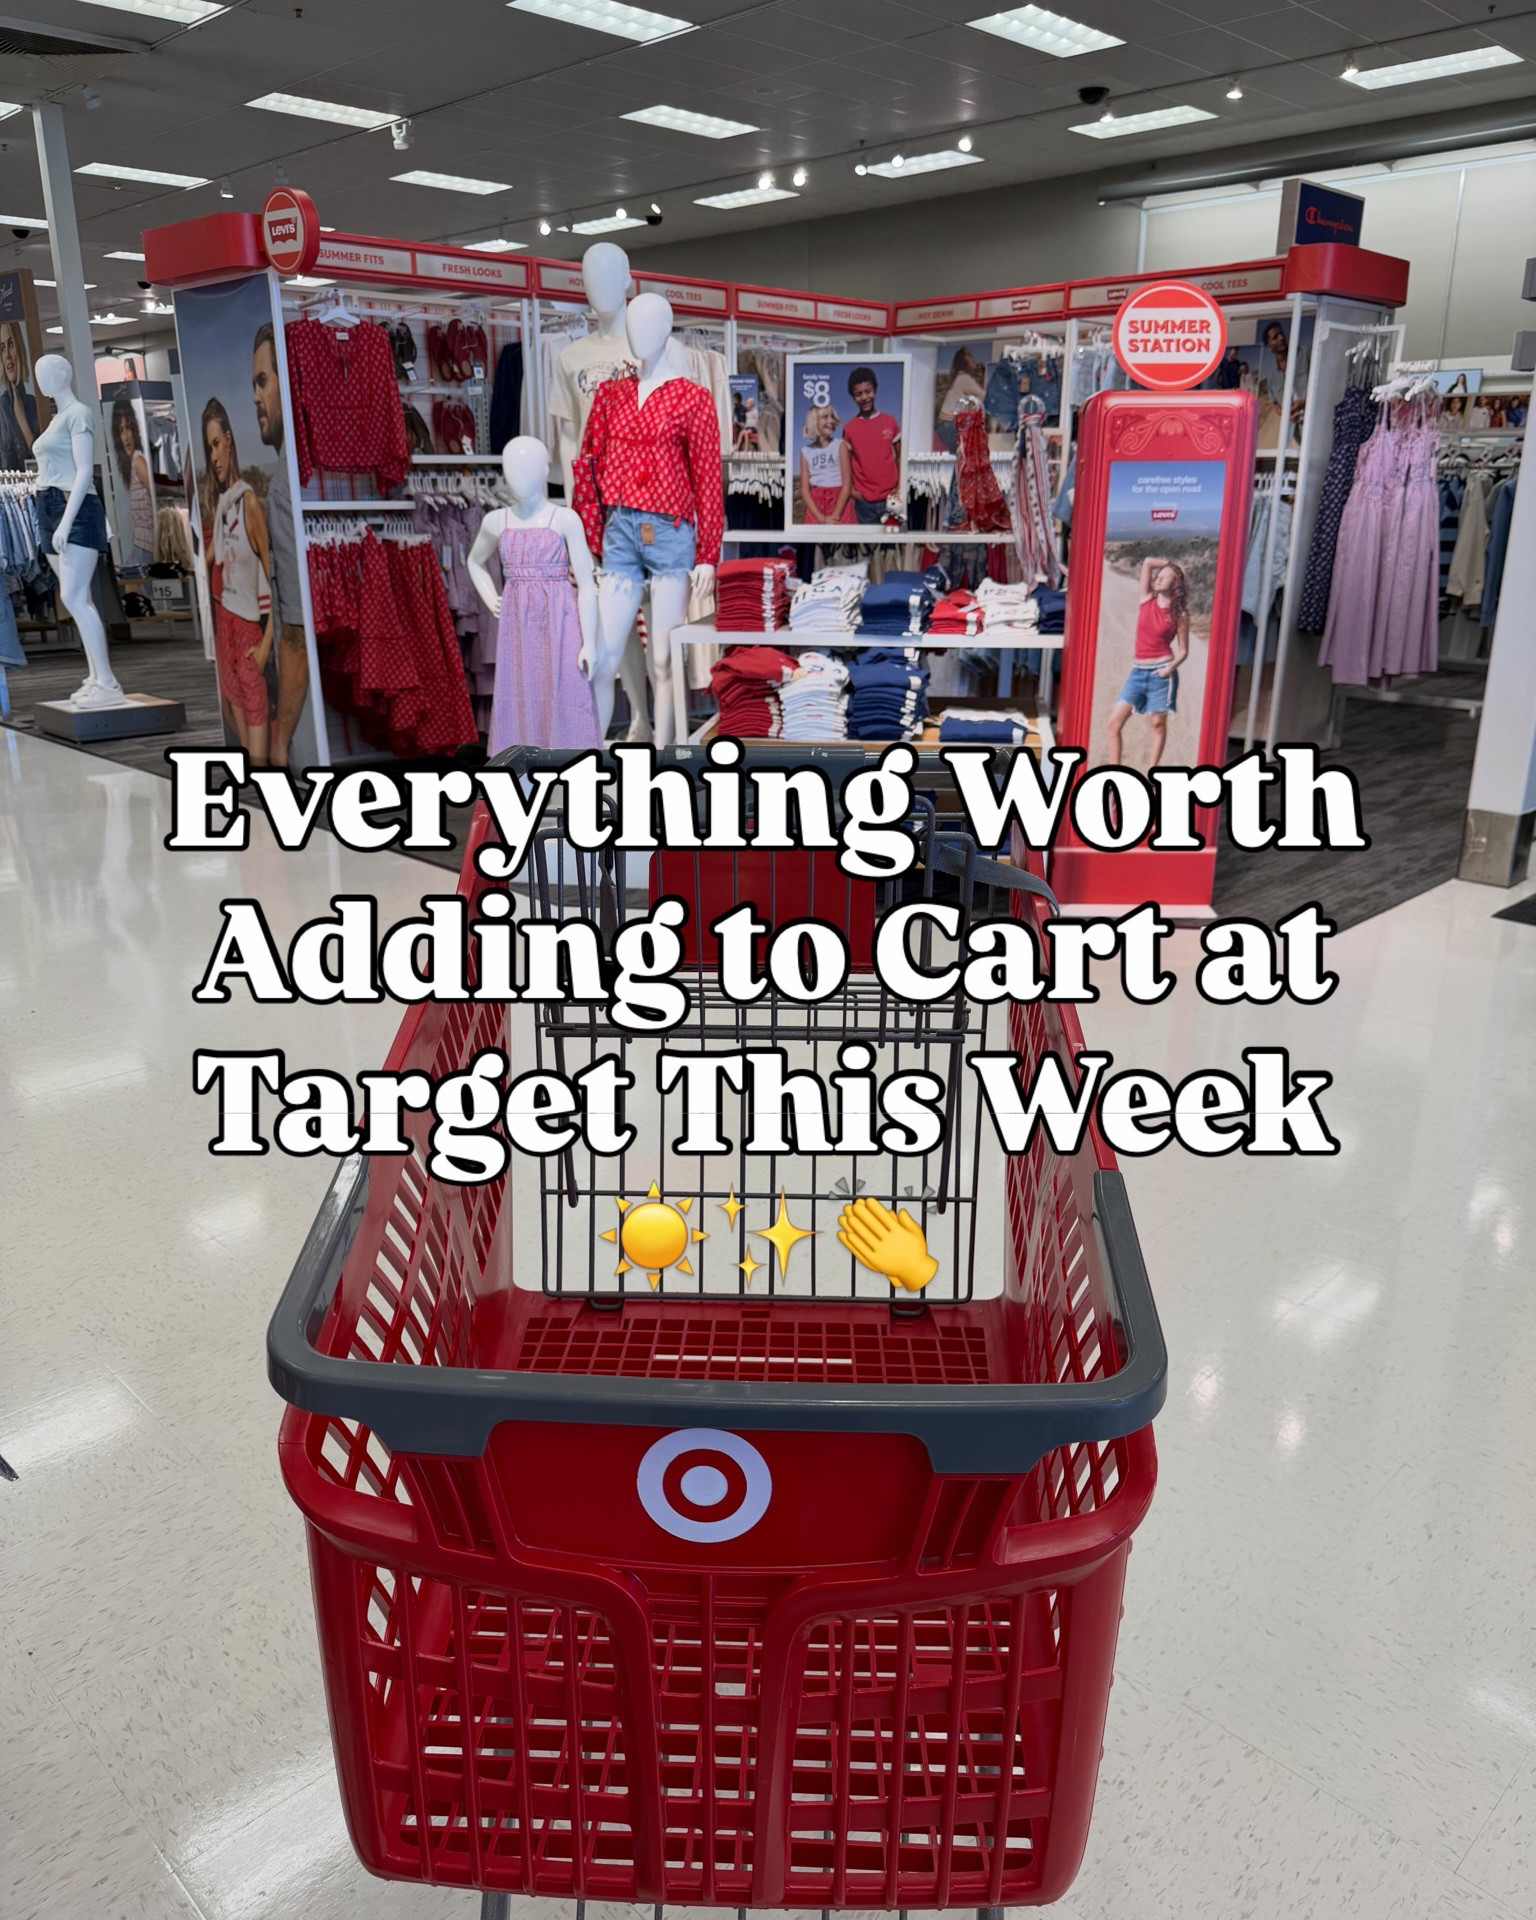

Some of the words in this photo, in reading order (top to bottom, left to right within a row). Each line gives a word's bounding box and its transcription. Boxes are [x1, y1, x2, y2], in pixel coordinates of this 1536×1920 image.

[1305, 207, 1354, 235] Champion
[317, 249, 361, 263] SUMMER
[363, 254, 384, 265] FITS
[442, 263, 471, 275] FRESH
[472, 266, 502, 278] LOOKS
[1201, 282, 1224, 291] COOL
[1228, 278, 1248, 289] TEES
[665, 289, 683, 300] COOL
[685, 291, 702, 302] TEES
[757, 300, 784, 311] SUMMER
[785, 304, 798, 313] FITS
[1128, 319, 1211, 334] SUMMER
[1128, 338, 1211, 352] STATION
[803, 381, 830, 407] $8
[812, 453, 834, 467] USA
[1137, 475, 1171, 484] carefree
[1173, 475, 1197, 486] styles
[1132, 485, 1144, 493] for
[1145, 485, 1158, 493] the
[1160, 486, 1181, 494] open
[1182, 485, 1202, 493] road
